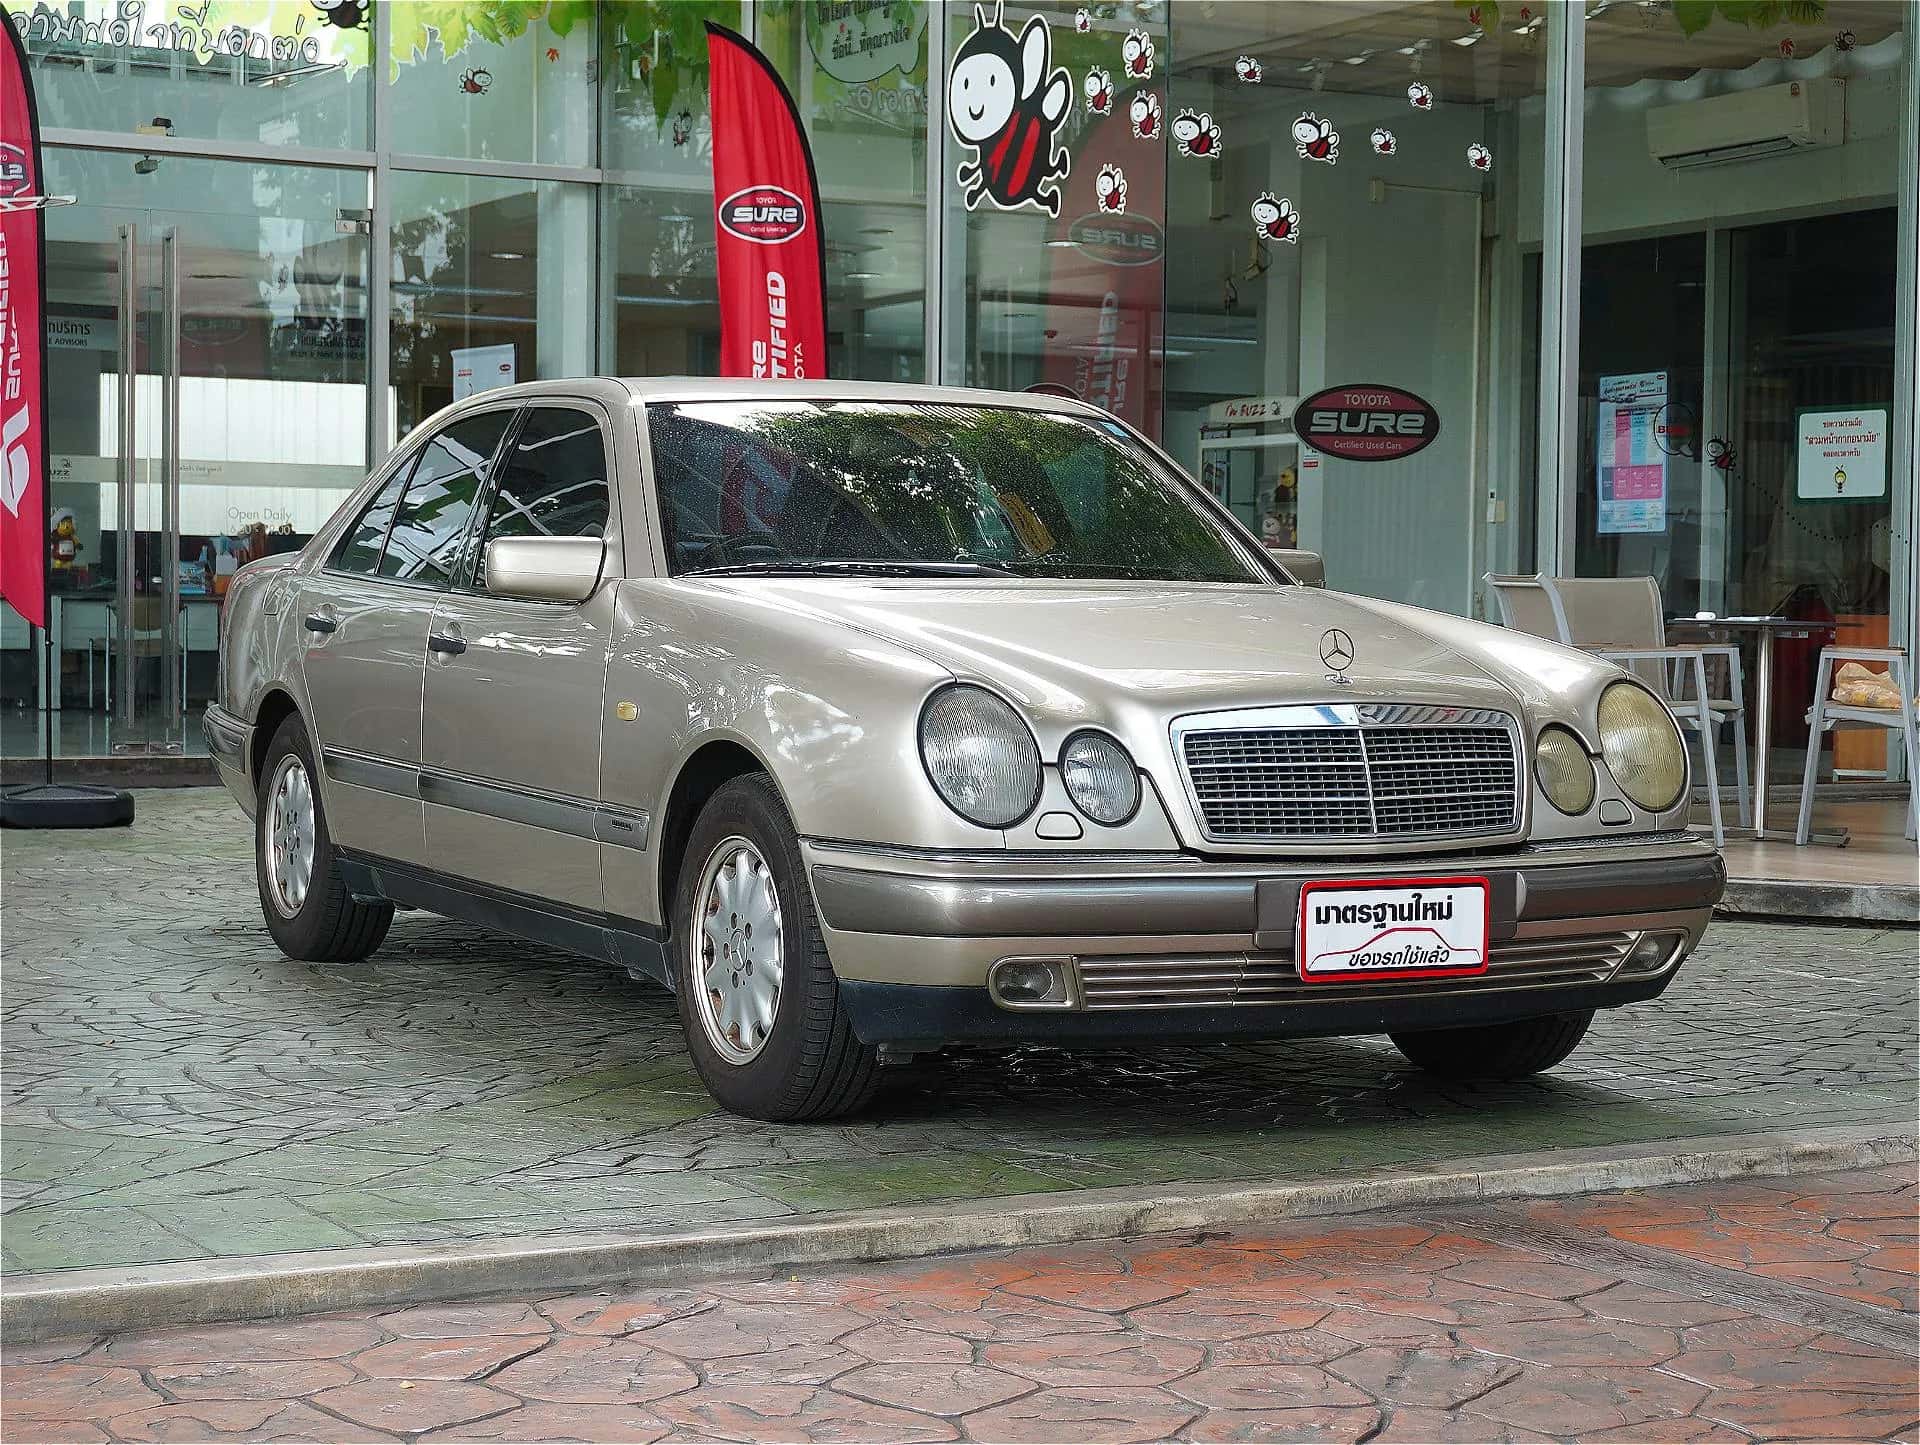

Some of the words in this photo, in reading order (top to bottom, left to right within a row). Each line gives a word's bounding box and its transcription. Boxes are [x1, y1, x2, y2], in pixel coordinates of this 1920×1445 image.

[733, 206, 798, 223] SURE
[1344, 393, 1392, 406] TOYOTA
[1310, 411, 1426, 434] SURE
[1334, 438, 1365, 450] Certified
[1366, 440, 1384, 450] Used
[1386, 441, 1402, 450] Cars
[228, 507, 259, 523] Open
[264, 507, 292, 523] Daily
[1315, 893, 1453, 929] มาตรฐานใหม่
[1349, 945, 1450, 967] ของรถใช้แล้ว
